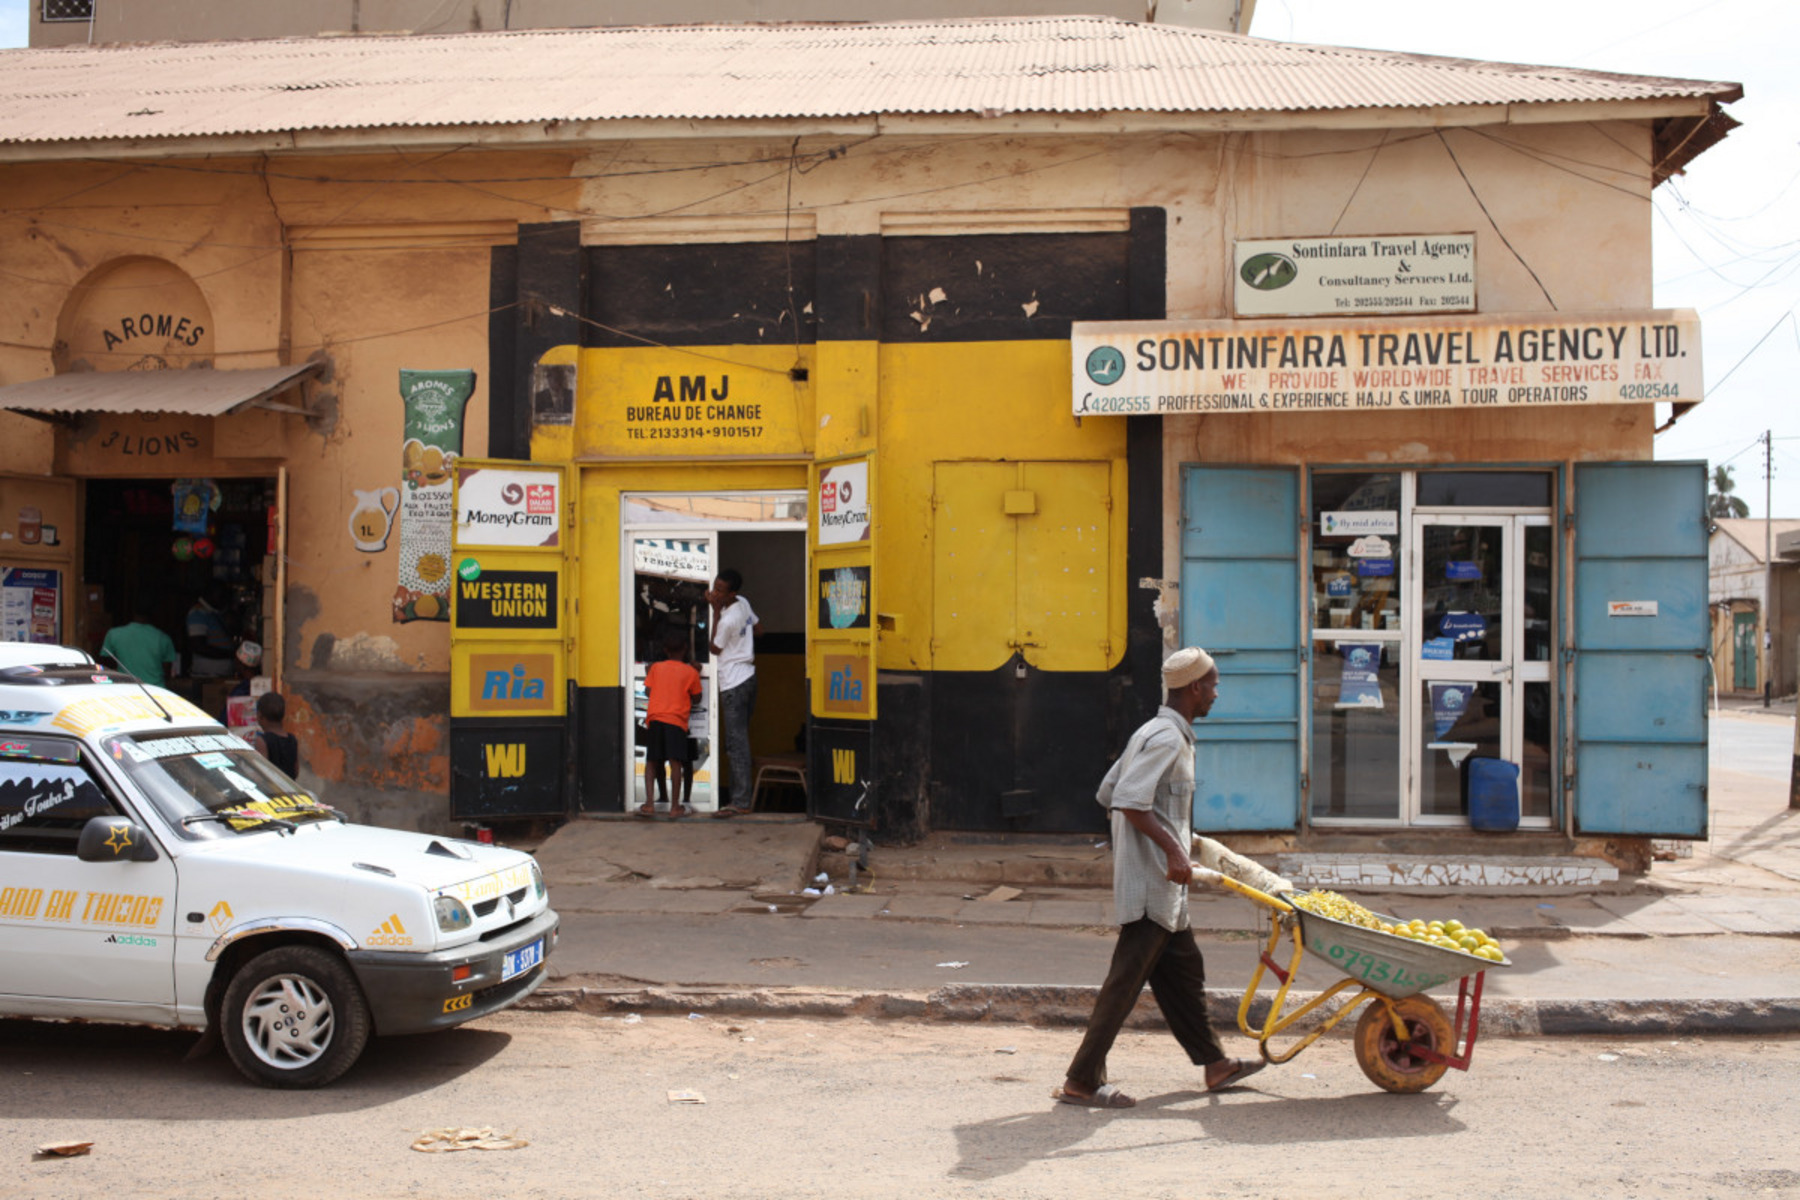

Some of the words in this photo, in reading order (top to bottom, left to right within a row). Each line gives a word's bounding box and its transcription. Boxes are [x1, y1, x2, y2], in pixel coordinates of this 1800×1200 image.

[1293, 243, 1367, 259] Sontinfara
[1371, 240, 1418, 257] Travel
[1421, 239, 1473, 259] Agency
[1398, 259, 1412, 273] &
[1319, 273, 1391, 288] Consultancy
[1395, 272, 1446, 286] Services
[1449, 271, 1473, 284] Ltd.
[1335, 297, 1350, 308] Tel:
[1419, 295, 1437, 306] Fax:
[103, 313, 205, 351] AROMES
[1136, 334, 1347, 372] SONTINFARA
[1358, 331, 1480, 367] TRAVEL
[1494, 326, 1627, 364] AGENCY
[1640, 325, 1686, 359] LTD.
[1222, 372, 1247, 390] WE
[1269, 371, 1338, 389] PROVIDE
[1353, 368, 1452, 388] WORLDWIDE
[1468, 366, 1526, 385] TRAVEL
[1541, 363, 1619, 383] SERVICES
[1634, 360, 1663, 380] FAX
[411, 380, 455, 396] AROMES
[653, 374, 729, 403] AMJ
[1091, 395, 1151, 412] 4202555
[1158, 393, 1255, 411] PROFFESSIONAL
[1259, 392, 1269, 408] &
[1273, 391, 1349, 409] EXPERIENCE
[1356, 390, 1392, 407] HAJJ
[1399, 390, 1411, 405] &
[1414, 389, 1451, 405] UMRA
[1461, 387, 1498, 404] TOUR
[1508, 385, 1588, 403] OPERATORS
[1620, 383, 1679, 399] 4202544
[627, 406, 681, 421] BUREAU
[685, 405, 702, 421] DE
[707, 404, 762, 420] CHANGE
[423, 418, 455, 433] LIONS
[102, 431, 119, 448] 3
[122, 431, 199, 456] LIONS
[467, 509, 553, 527] MoneyGram
[1371, 518, 1394, 528] africa
[361, 525, 375, 537] 1L
[461, 581, 547, 600] WESTERN
[491, 599, 547, 617] UNION
[481, 663, 545, 699] Ria
[829, 664, 862, 702] Ria
[485, 743, 526, 778] WU
[44, 889, 79, 919] AK
[117, 934, 157, 947] adidas
[366, 934, 413, 946] adidas
